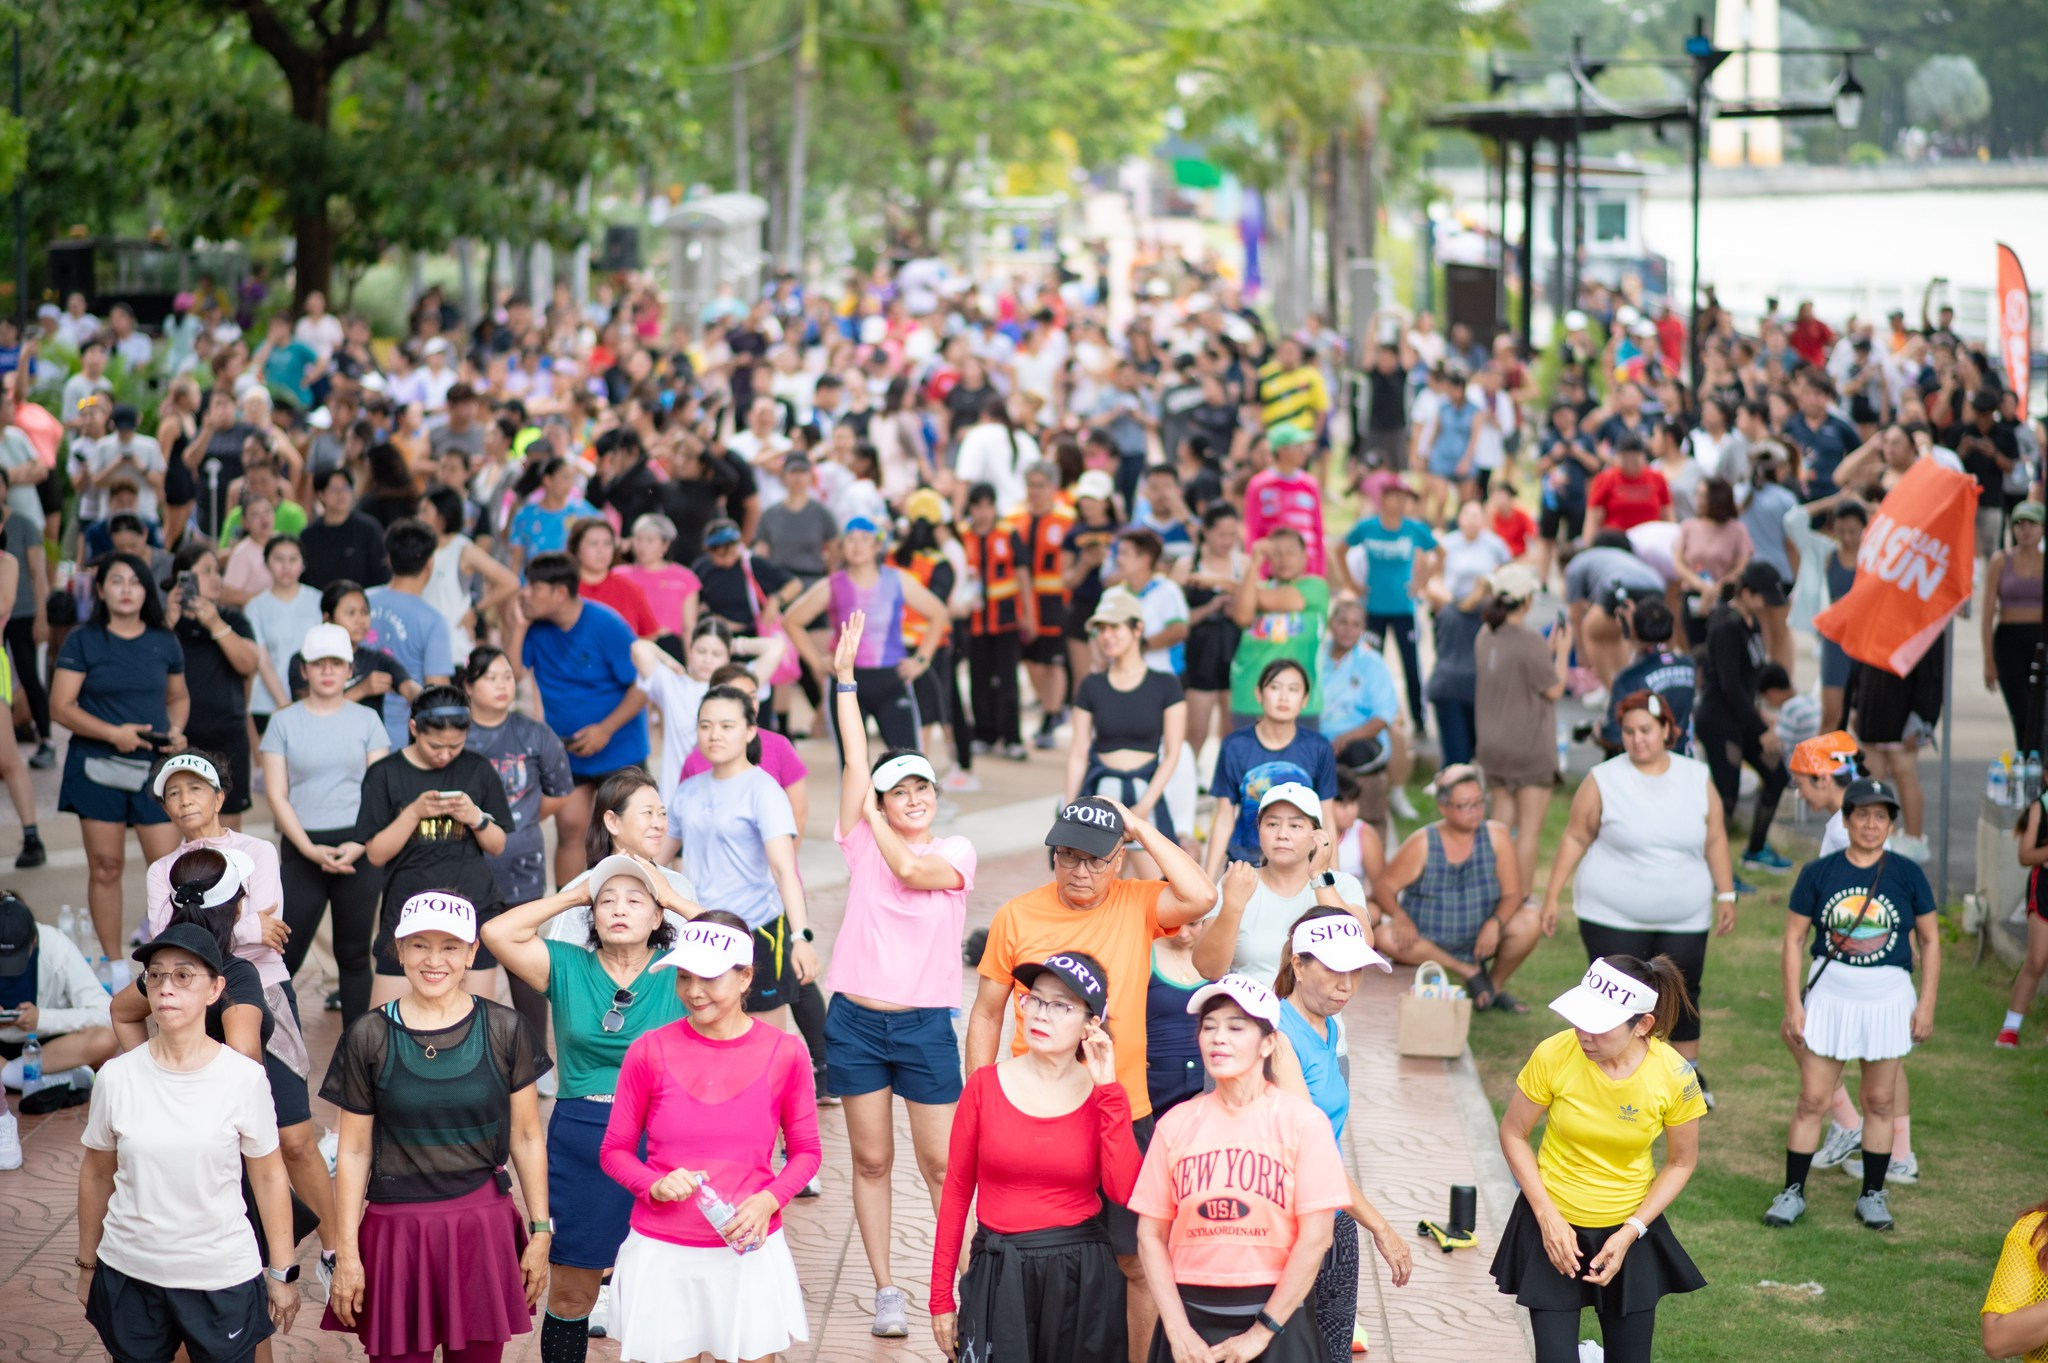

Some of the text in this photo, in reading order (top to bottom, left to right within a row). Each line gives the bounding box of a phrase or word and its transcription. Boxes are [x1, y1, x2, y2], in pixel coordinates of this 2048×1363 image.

[403, 898, 473, 920] SPORT
[1223, 1148, 1288, 1210] YORK
[1205, 1200, 1240, 1220] USA
